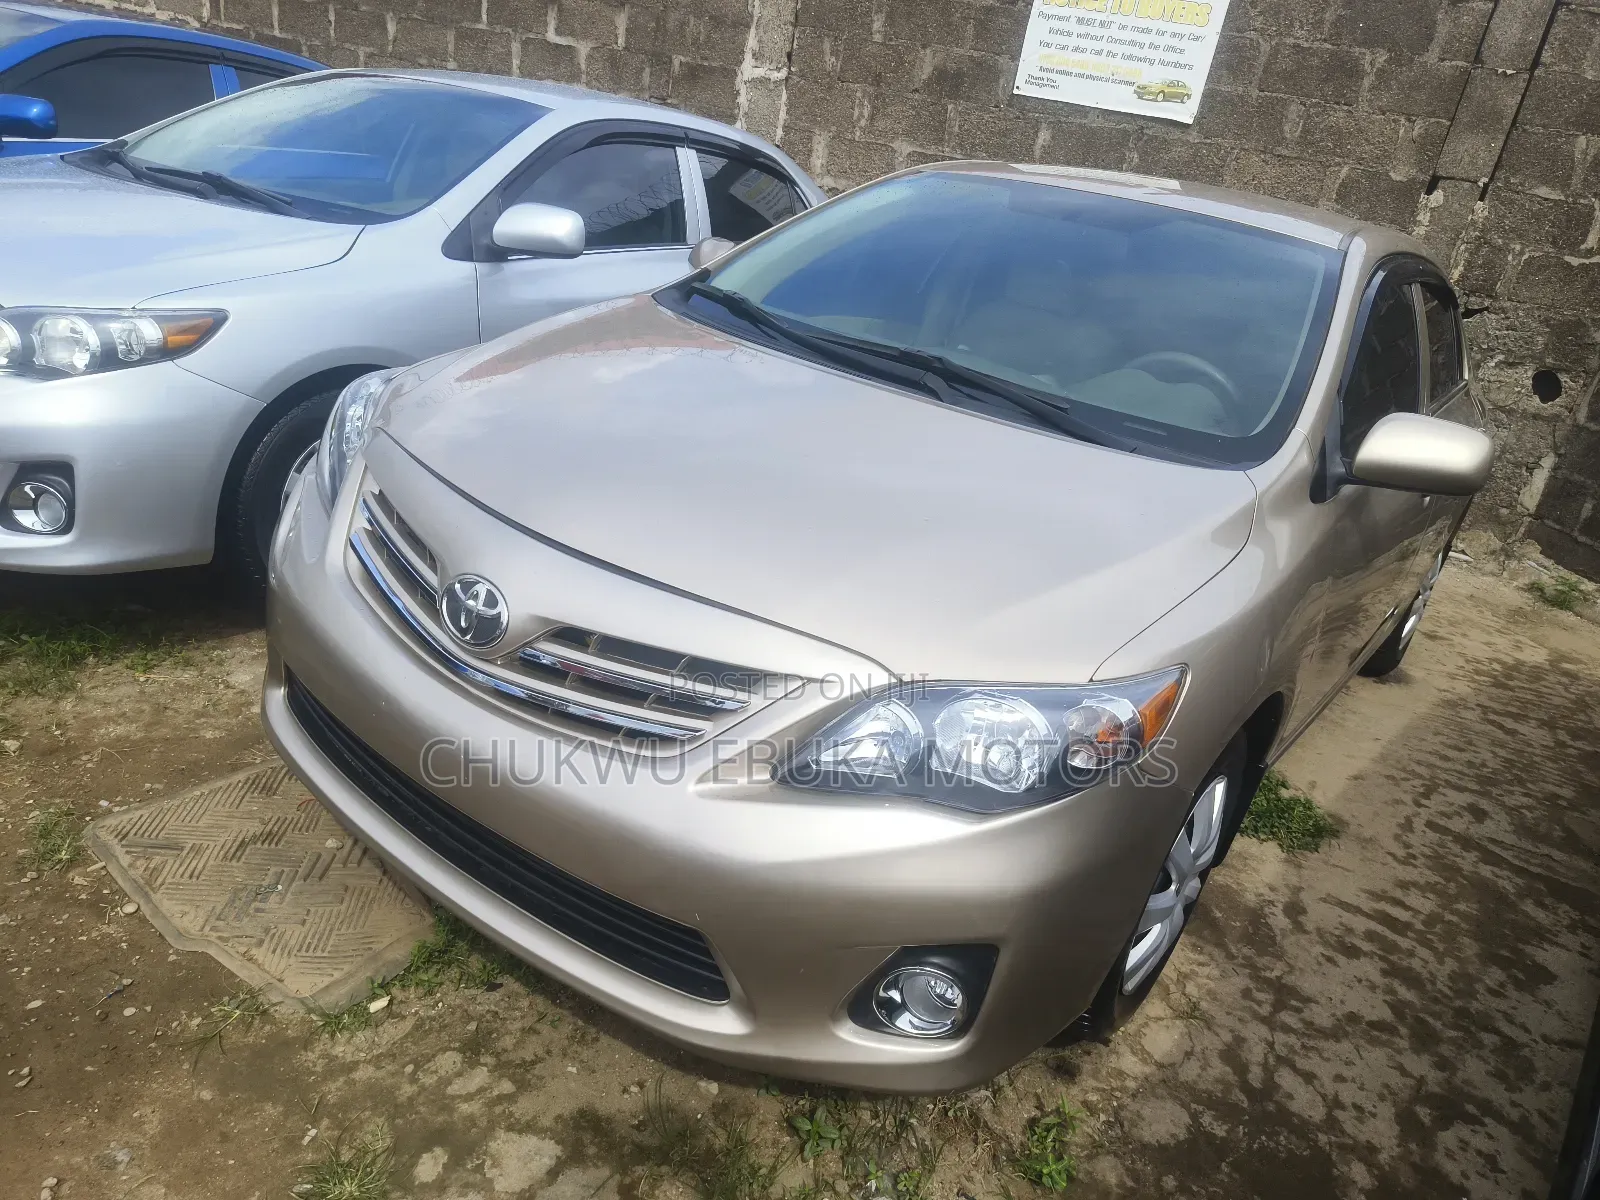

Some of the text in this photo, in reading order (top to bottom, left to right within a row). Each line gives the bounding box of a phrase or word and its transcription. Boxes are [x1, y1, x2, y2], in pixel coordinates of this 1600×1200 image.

[1135, 0, 1212, 27] BUYERS
[1038, 11, 1071, 22] Payment
[1118, 23, 1128, 31] be
[1130, 25, 1153, 35] made
[1155, 27, 1167, 37] for
[1169, 31, 1186, 41] any
[1048, 27, 1073, 37] Vehicle
[1076, 31, 1104, 42] without
[1106, 35, 1146, 49] Consulting
[1147, 41, 1160, 51] the
[1038, 39, 1194, 71] You can also call the following Numbers
[1024, 79, 1060, 90] Management
[1027, 73, 1057, 84] Thank You
[1074, 71, 1086, 80] and
[1085, 73, 1111, 83] physical
